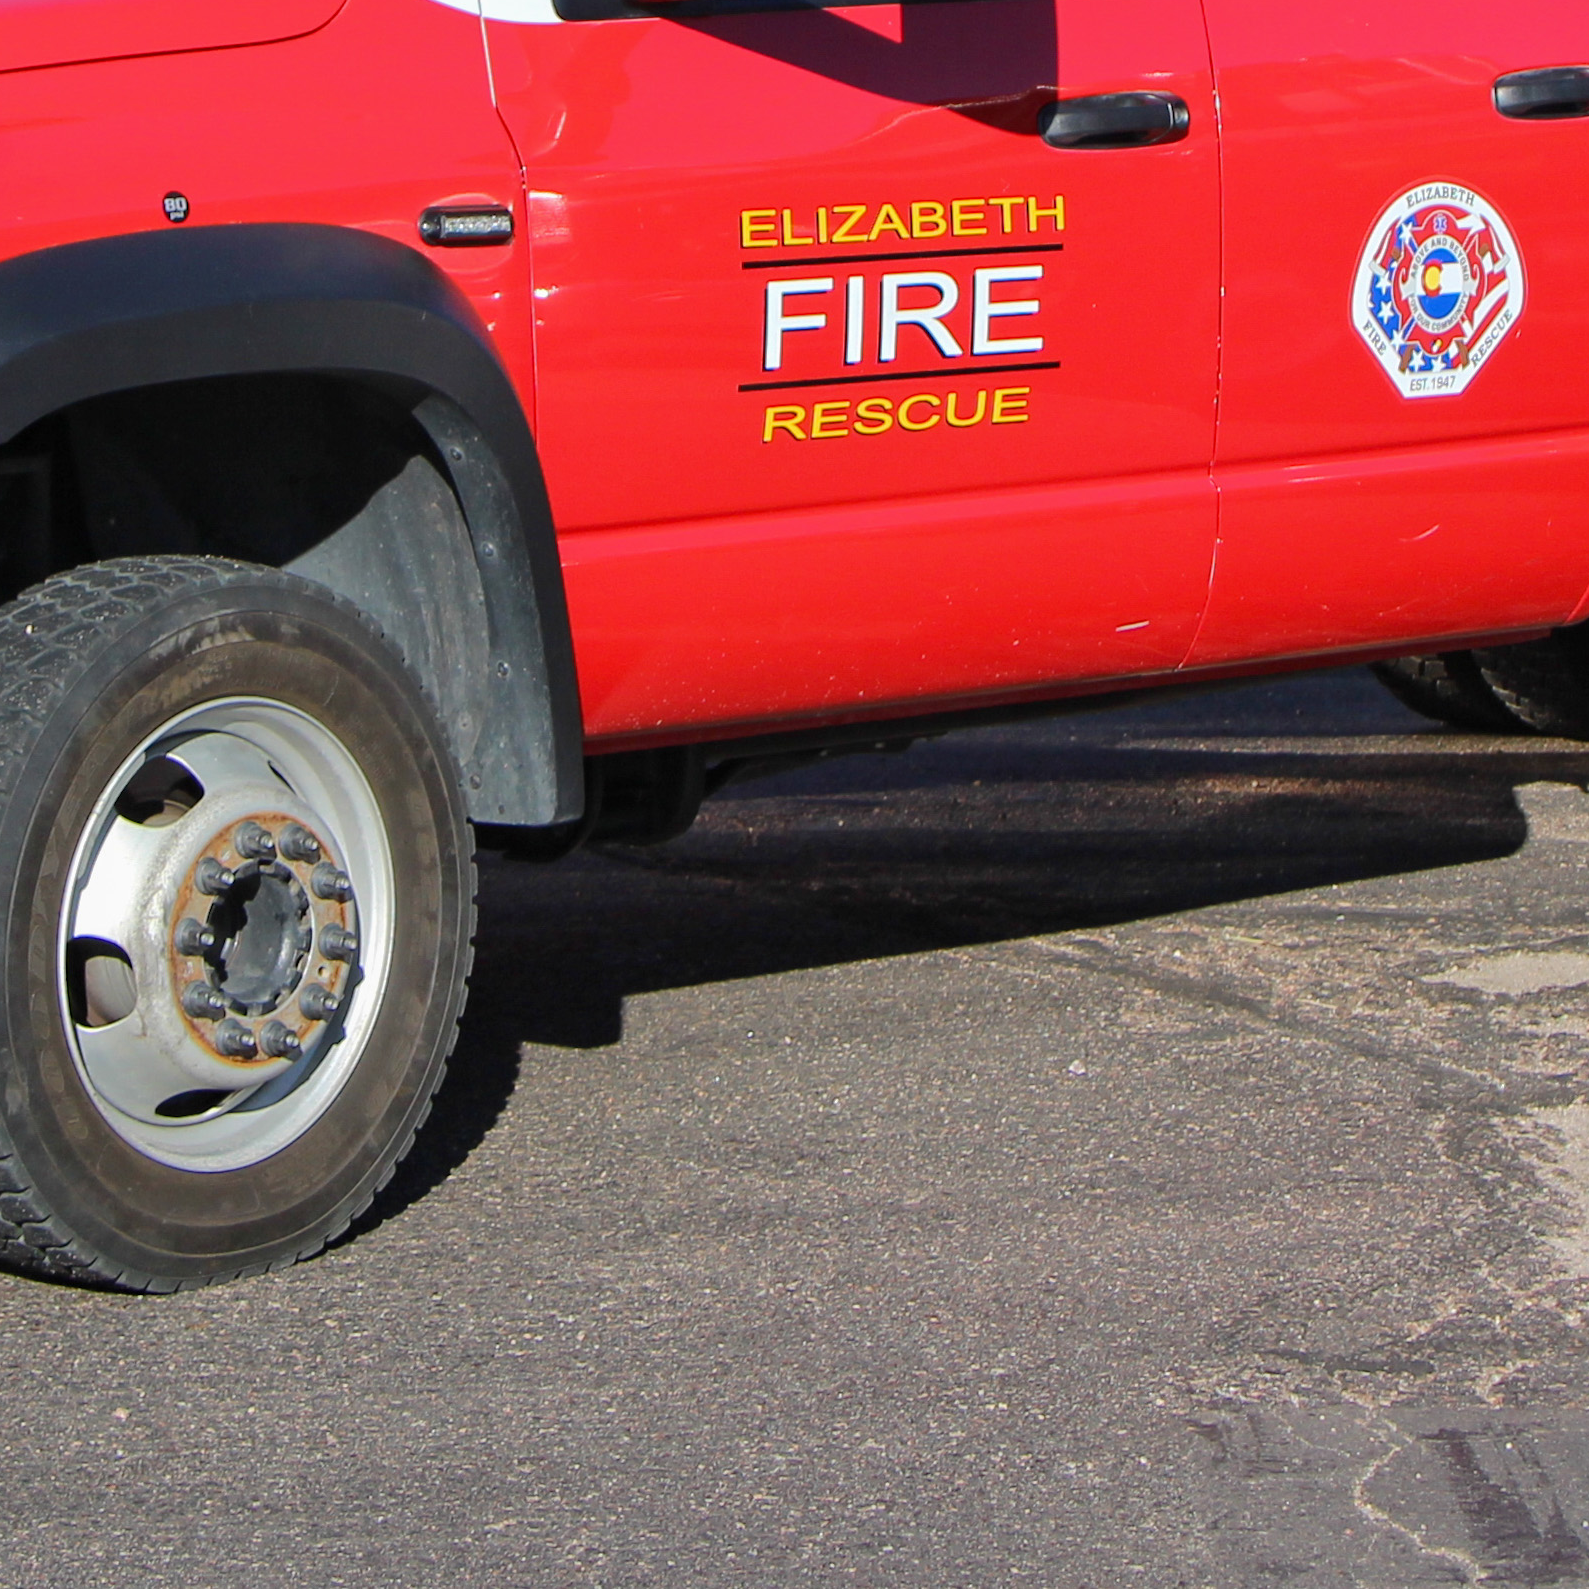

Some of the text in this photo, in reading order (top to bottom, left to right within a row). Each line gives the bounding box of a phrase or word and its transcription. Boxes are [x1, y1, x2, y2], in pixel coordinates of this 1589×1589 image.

[741, 195, 1066, 248] ELIZABETH
[1406, 186, 1475, 209] ELIZABETH
[1431, 237, 1448, 248] AND
[1449, 241, 1470, 282] BEYOND
[764, 264, 1045, 370] FIRE
[1362, 320, 1387, 356] FIRE
[1471, 309, 1513, 368] RESCUE
[763, 386, 1030, 443] RESCUE
